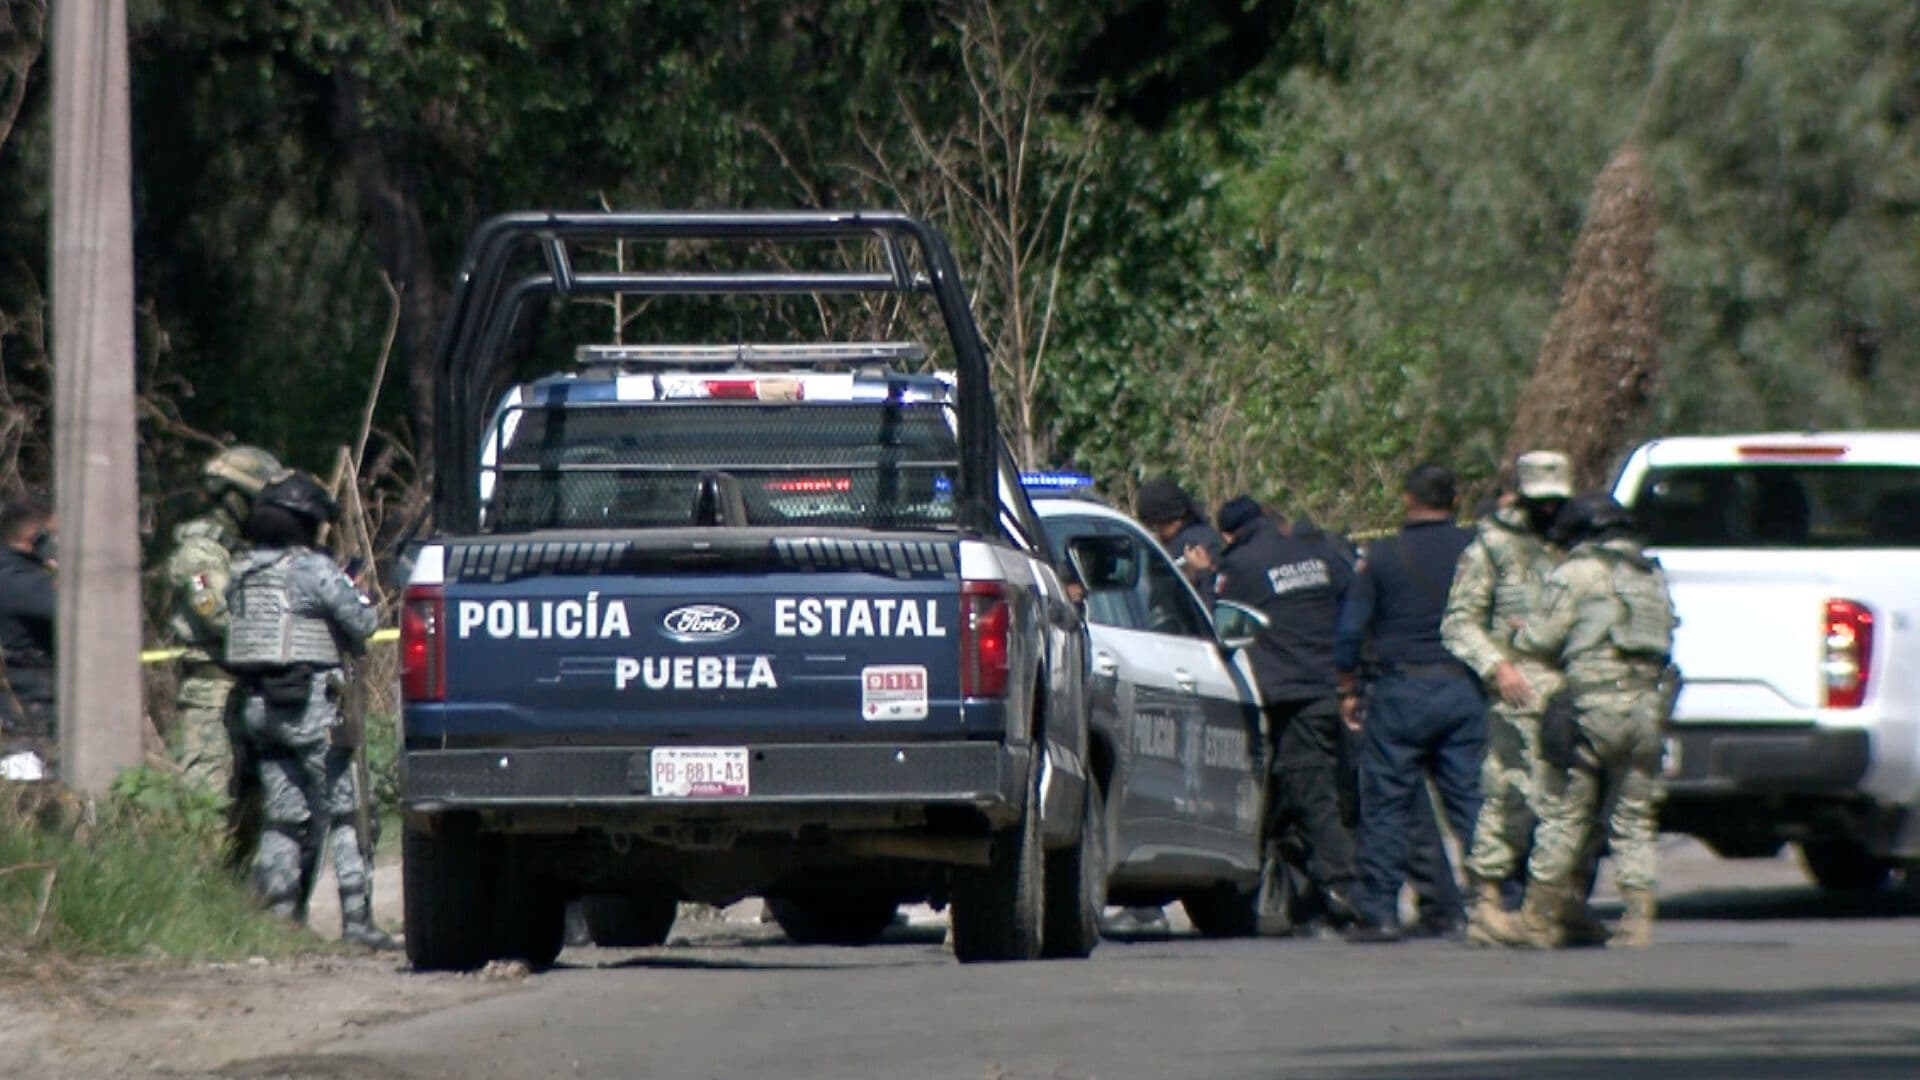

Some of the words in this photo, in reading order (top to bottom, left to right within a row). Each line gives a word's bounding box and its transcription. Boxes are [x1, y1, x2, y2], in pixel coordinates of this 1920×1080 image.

[459, 591, 631, 638] POLICÍA
[775, 599, 946, 637] ESTATAL
[677, 609, 727, 632] Ford
[615, 656, 777, 689] PUEBLA
[869, 674, 919, 690] 911
